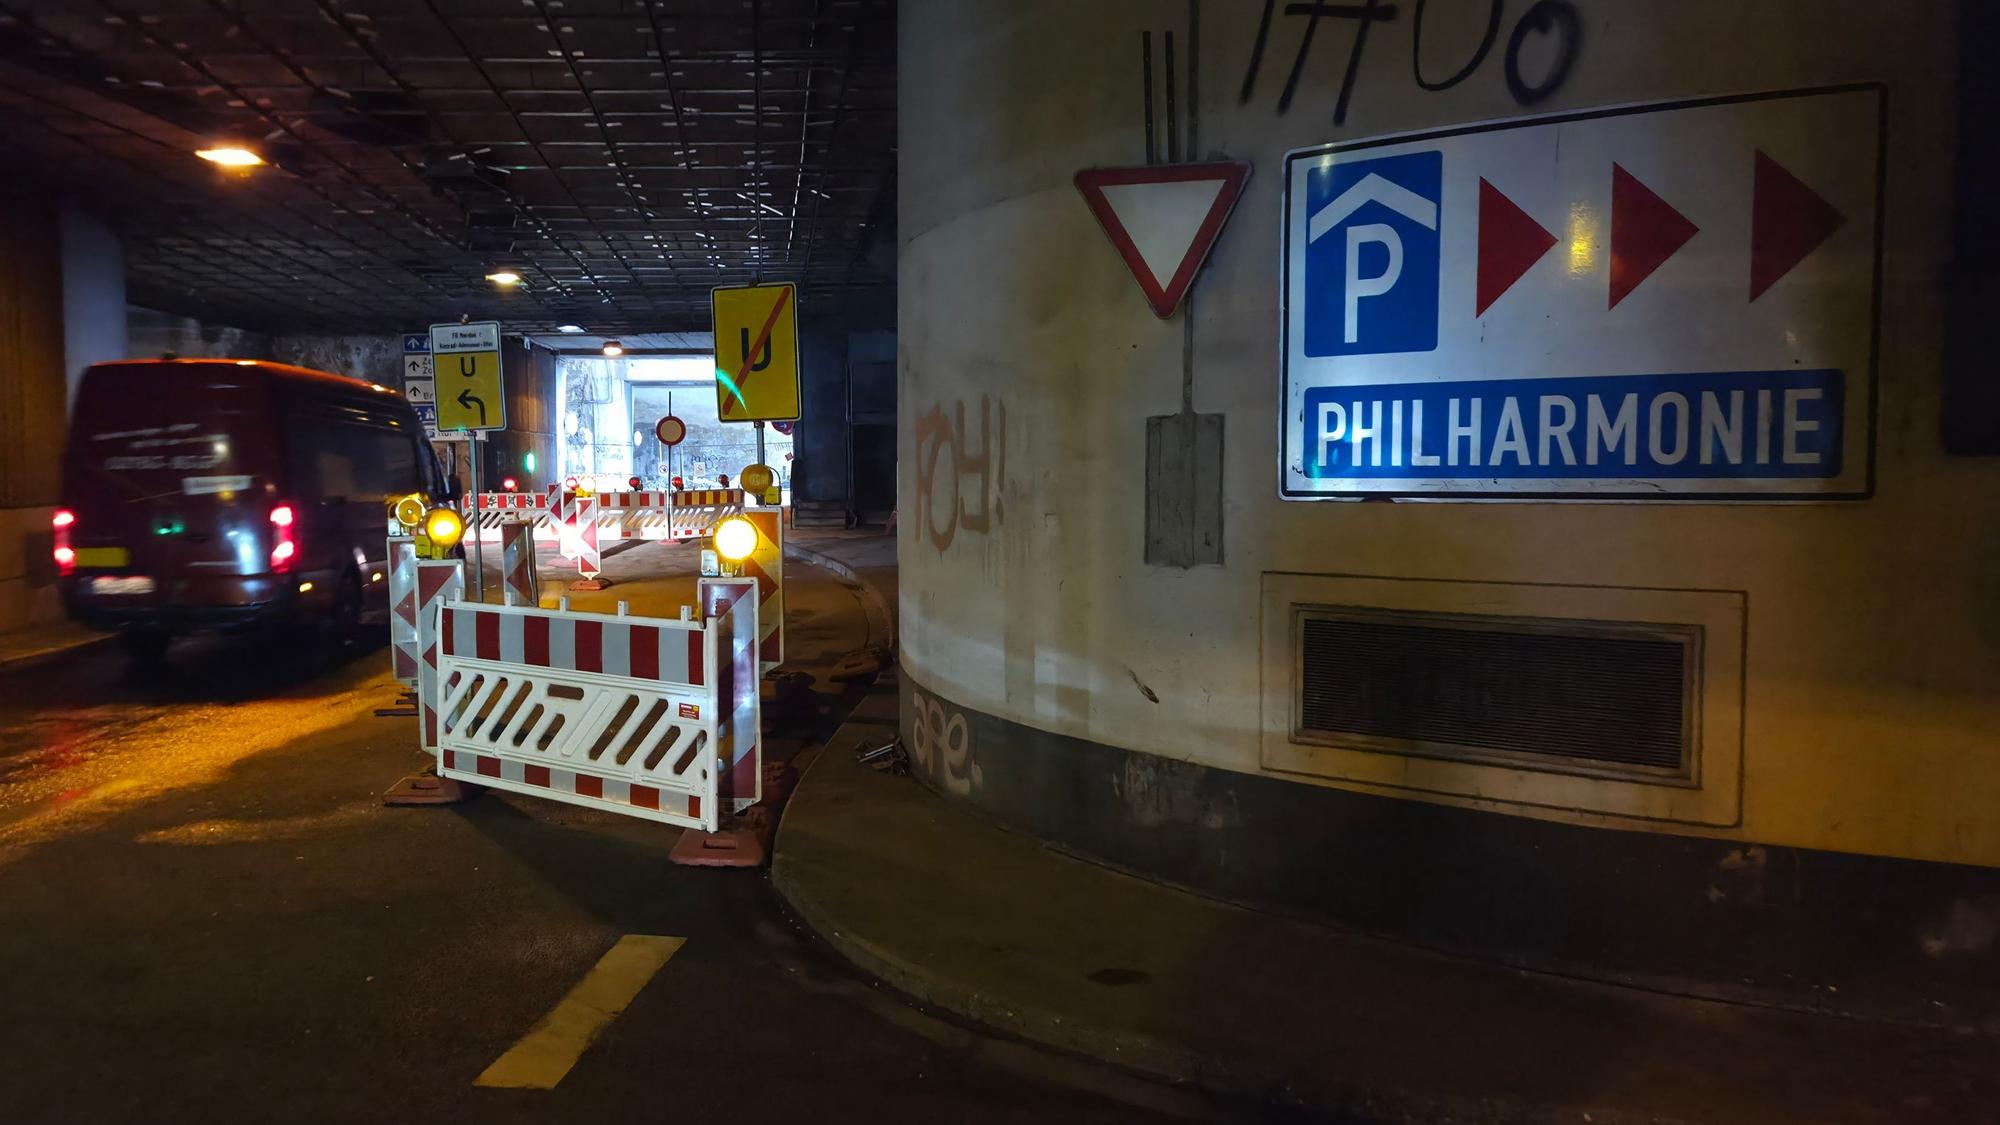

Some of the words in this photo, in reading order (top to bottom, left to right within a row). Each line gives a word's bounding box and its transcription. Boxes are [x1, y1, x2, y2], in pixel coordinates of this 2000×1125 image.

[1334, 223, 1403, 343] P
[460, 357, 476, 377] U
[741, 327, 772, 372] U
[1318, 388, 1822, 466] PHILHARMONIE
